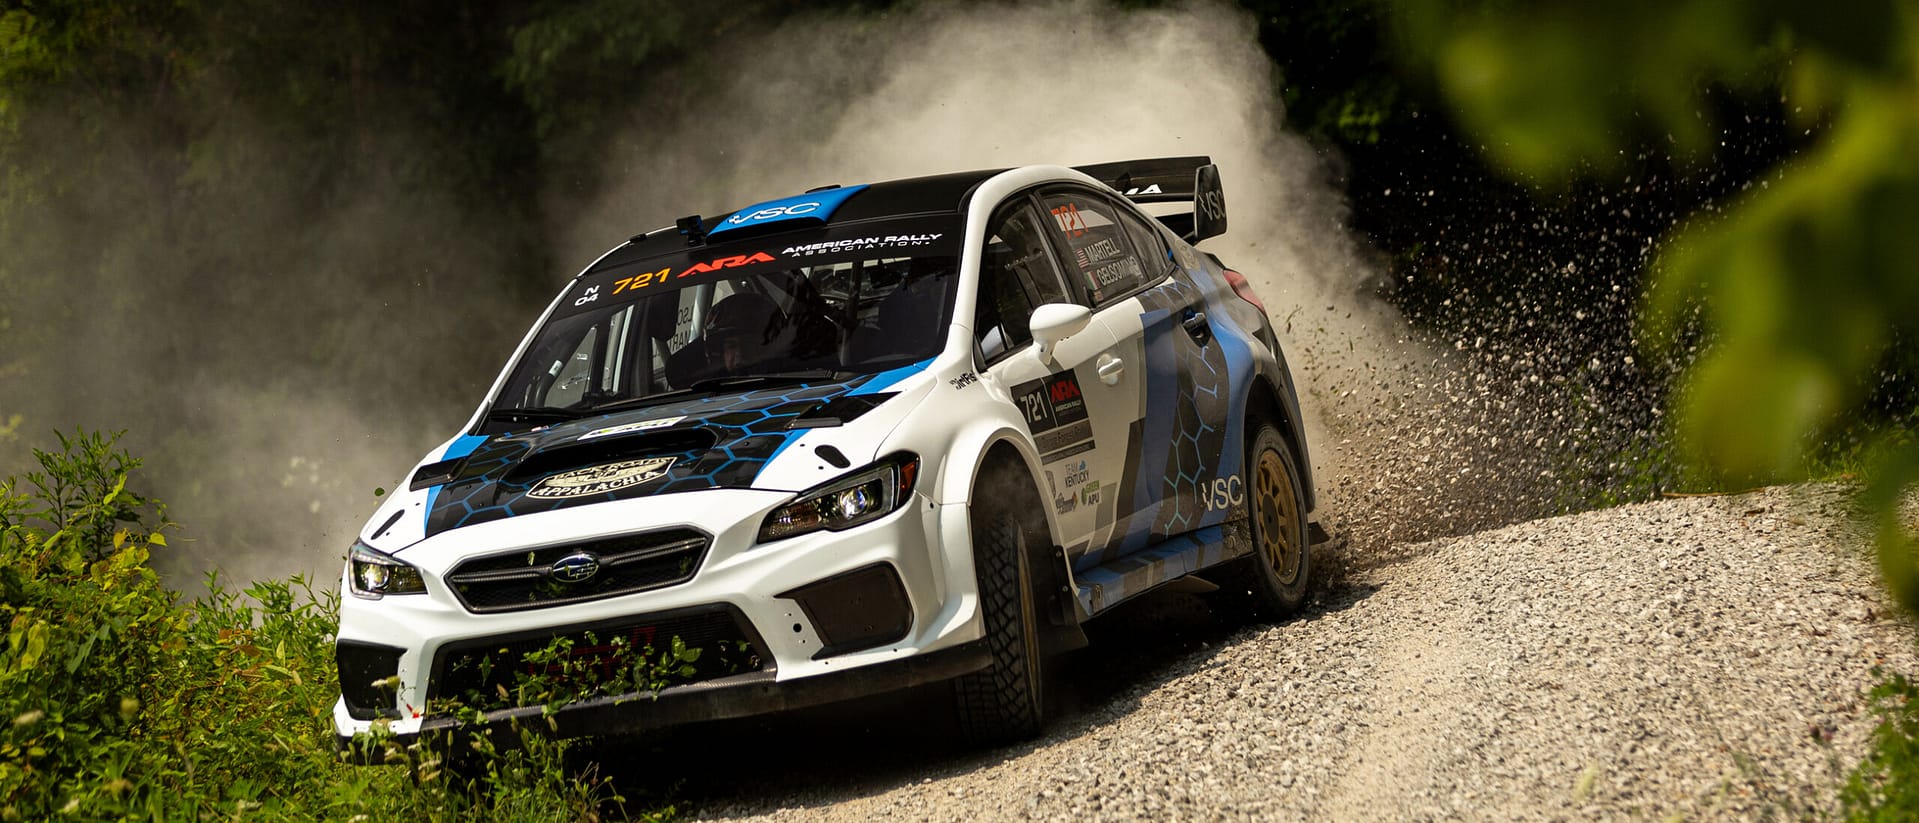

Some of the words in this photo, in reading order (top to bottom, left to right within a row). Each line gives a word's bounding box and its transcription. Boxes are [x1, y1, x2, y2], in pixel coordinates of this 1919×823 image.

[728, 202, 821, 224] VSC
[1050, 203, 1089, 240] 721
[781, 236, 880, 255] AMERICAN
[884, 233, 943, 245] RALLY
[1084, 238, 1120, 265] MARTELL
[676, 251, 776, 279] ARA
[584, 285, 600, 296] N
[612, 267, 672, 295] 721
[574, 293, 600, 306] 04
[1020, 391, 1048, 424] 721
[1051, 379, 1081, 404] ARA
[532, 471, 660, 496] APPALACHIA
[1065, 470, 1089, 488] KENTUCKY
[1201, 475, 1243, 512] VSC
